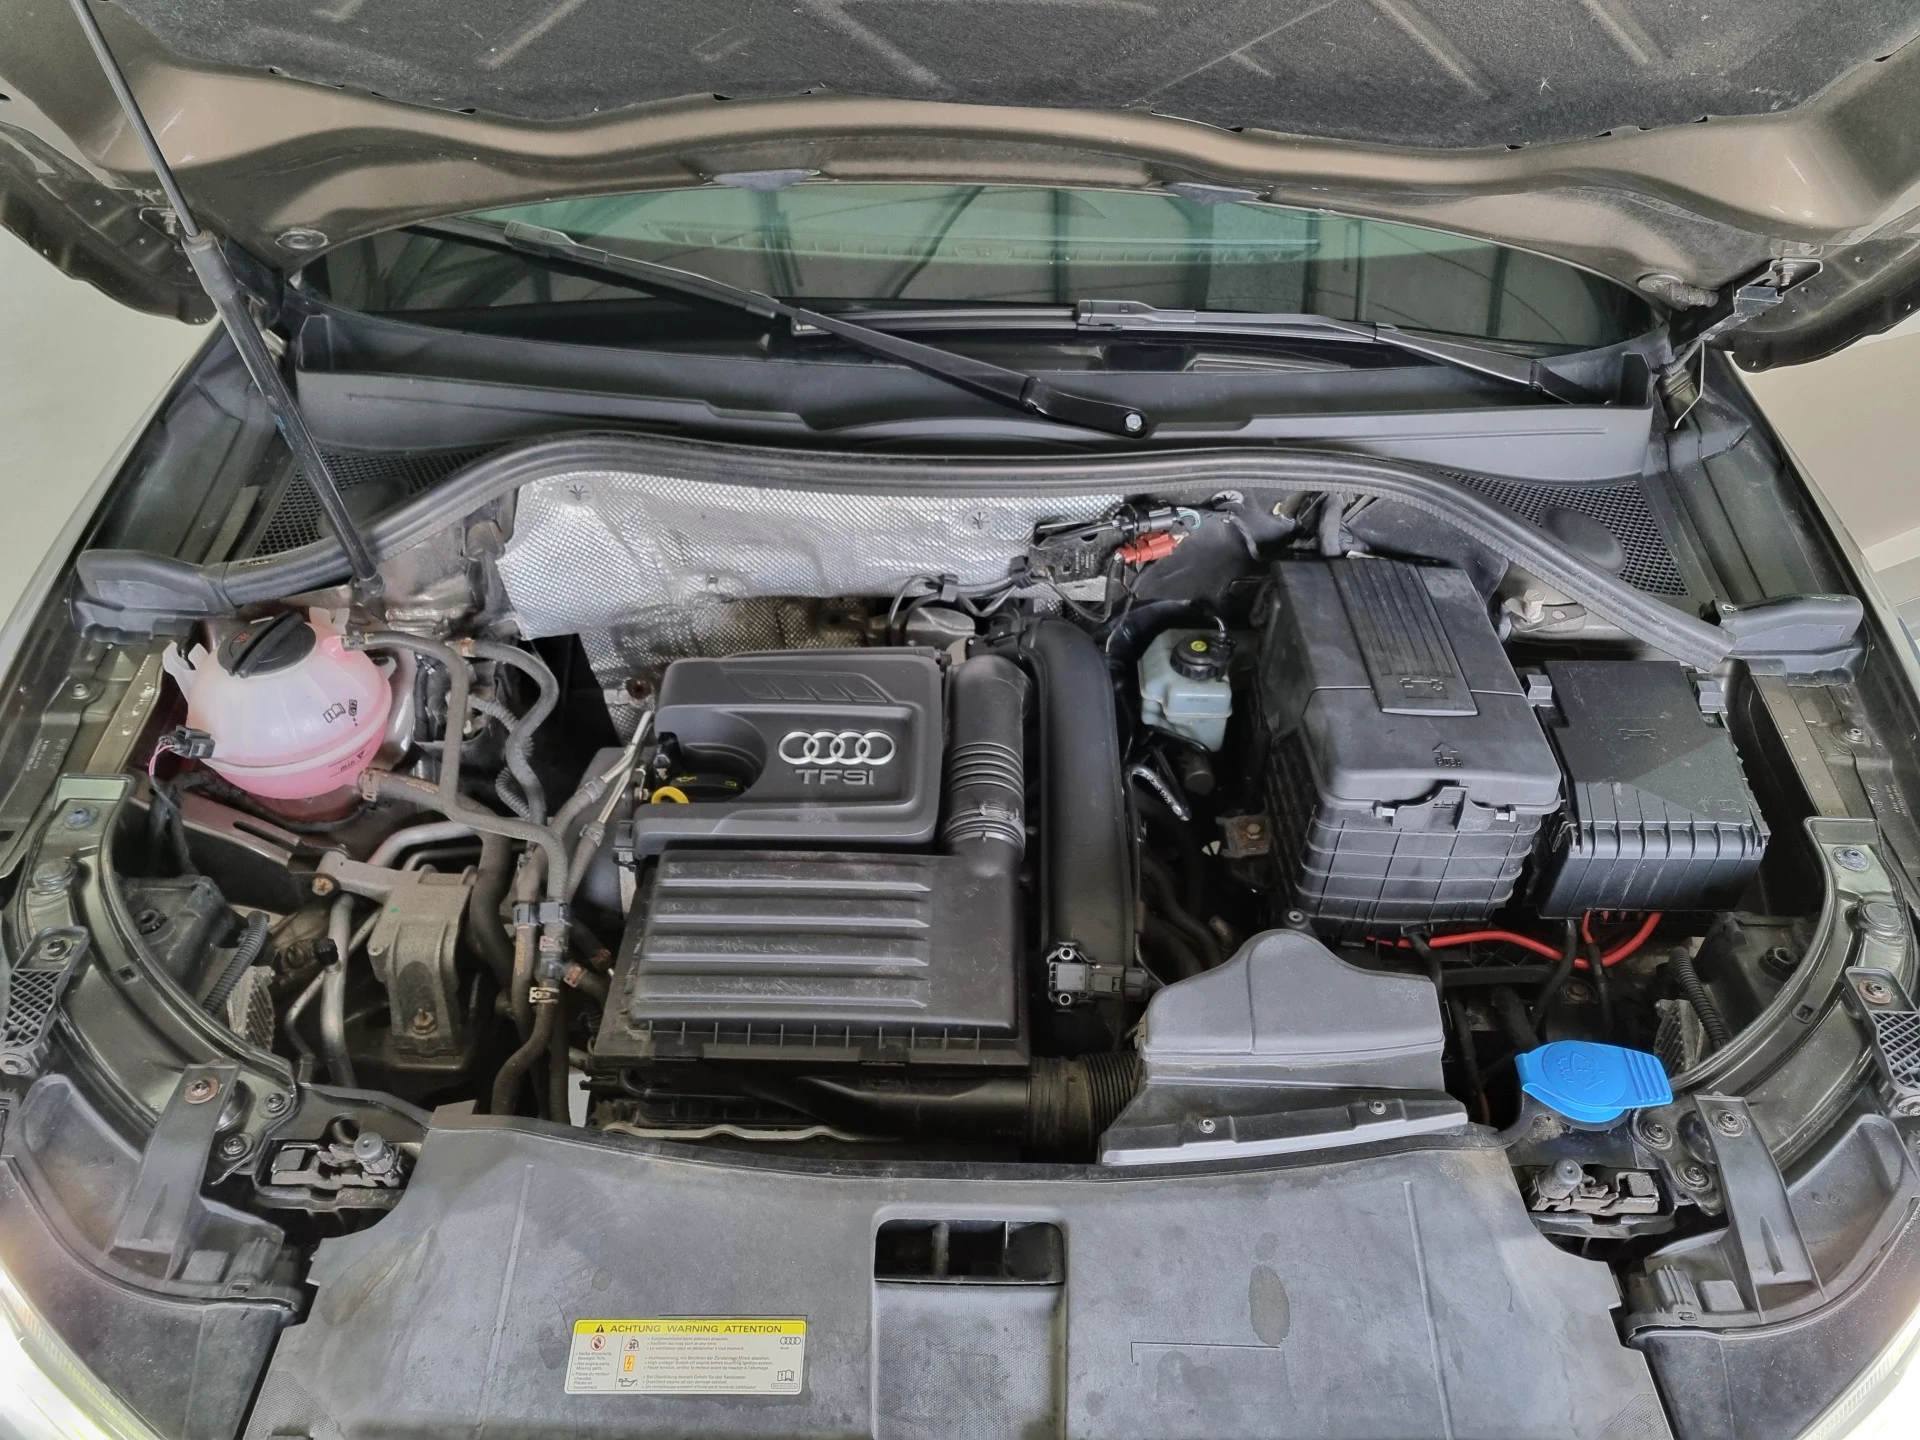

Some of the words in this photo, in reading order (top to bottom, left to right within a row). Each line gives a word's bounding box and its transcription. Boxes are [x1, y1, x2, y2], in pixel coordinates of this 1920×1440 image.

[340, 760, 355, 772] min
[795, 769, 875, 785] TFSI
[610, 1325, 661, 1333] ACHTUNG
[667, 1325, 719, 1333] WARNING
[724, 1325, 782, 1333] ATTENTION
